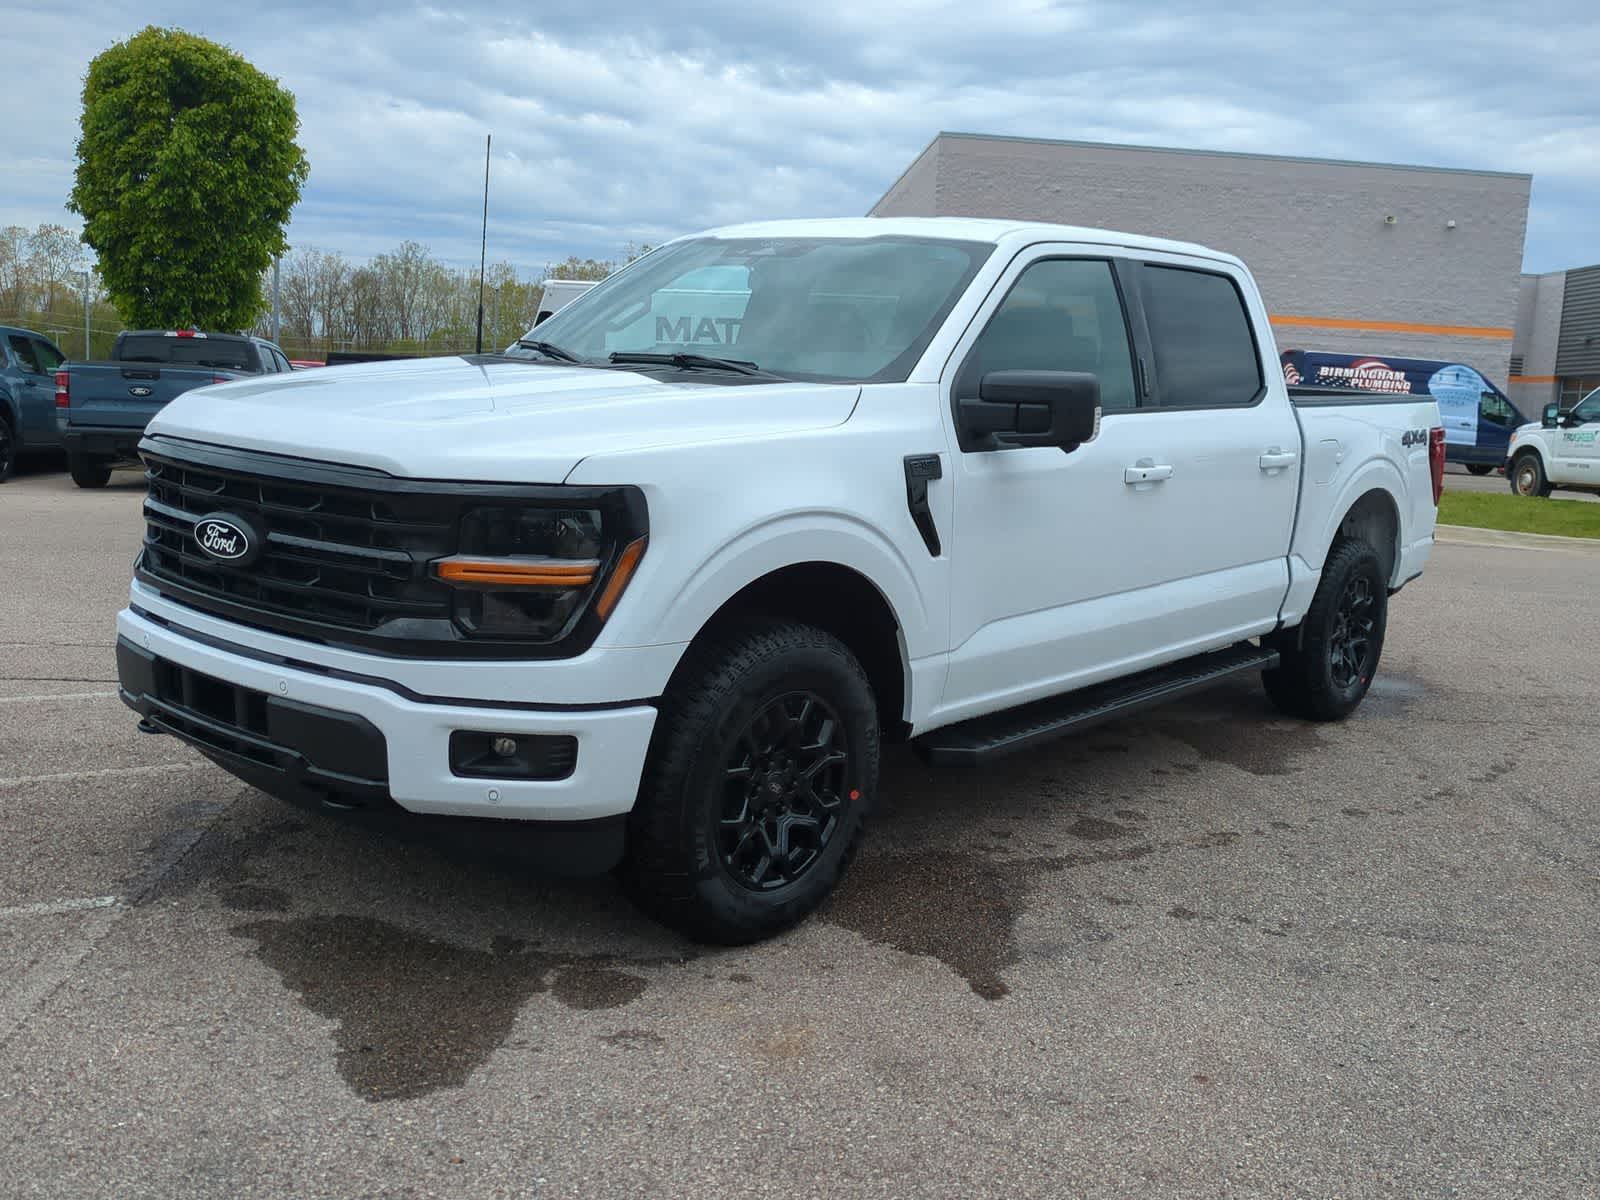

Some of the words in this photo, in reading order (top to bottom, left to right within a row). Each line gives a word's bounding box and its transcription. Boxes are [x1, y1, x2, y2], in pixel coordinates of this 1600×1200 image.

[1320, 366, 1405, 381] BIRMINGHAM
[1350, 378, 1411, 390] PLUMBING
[203, 523, 236, 553] Ford
